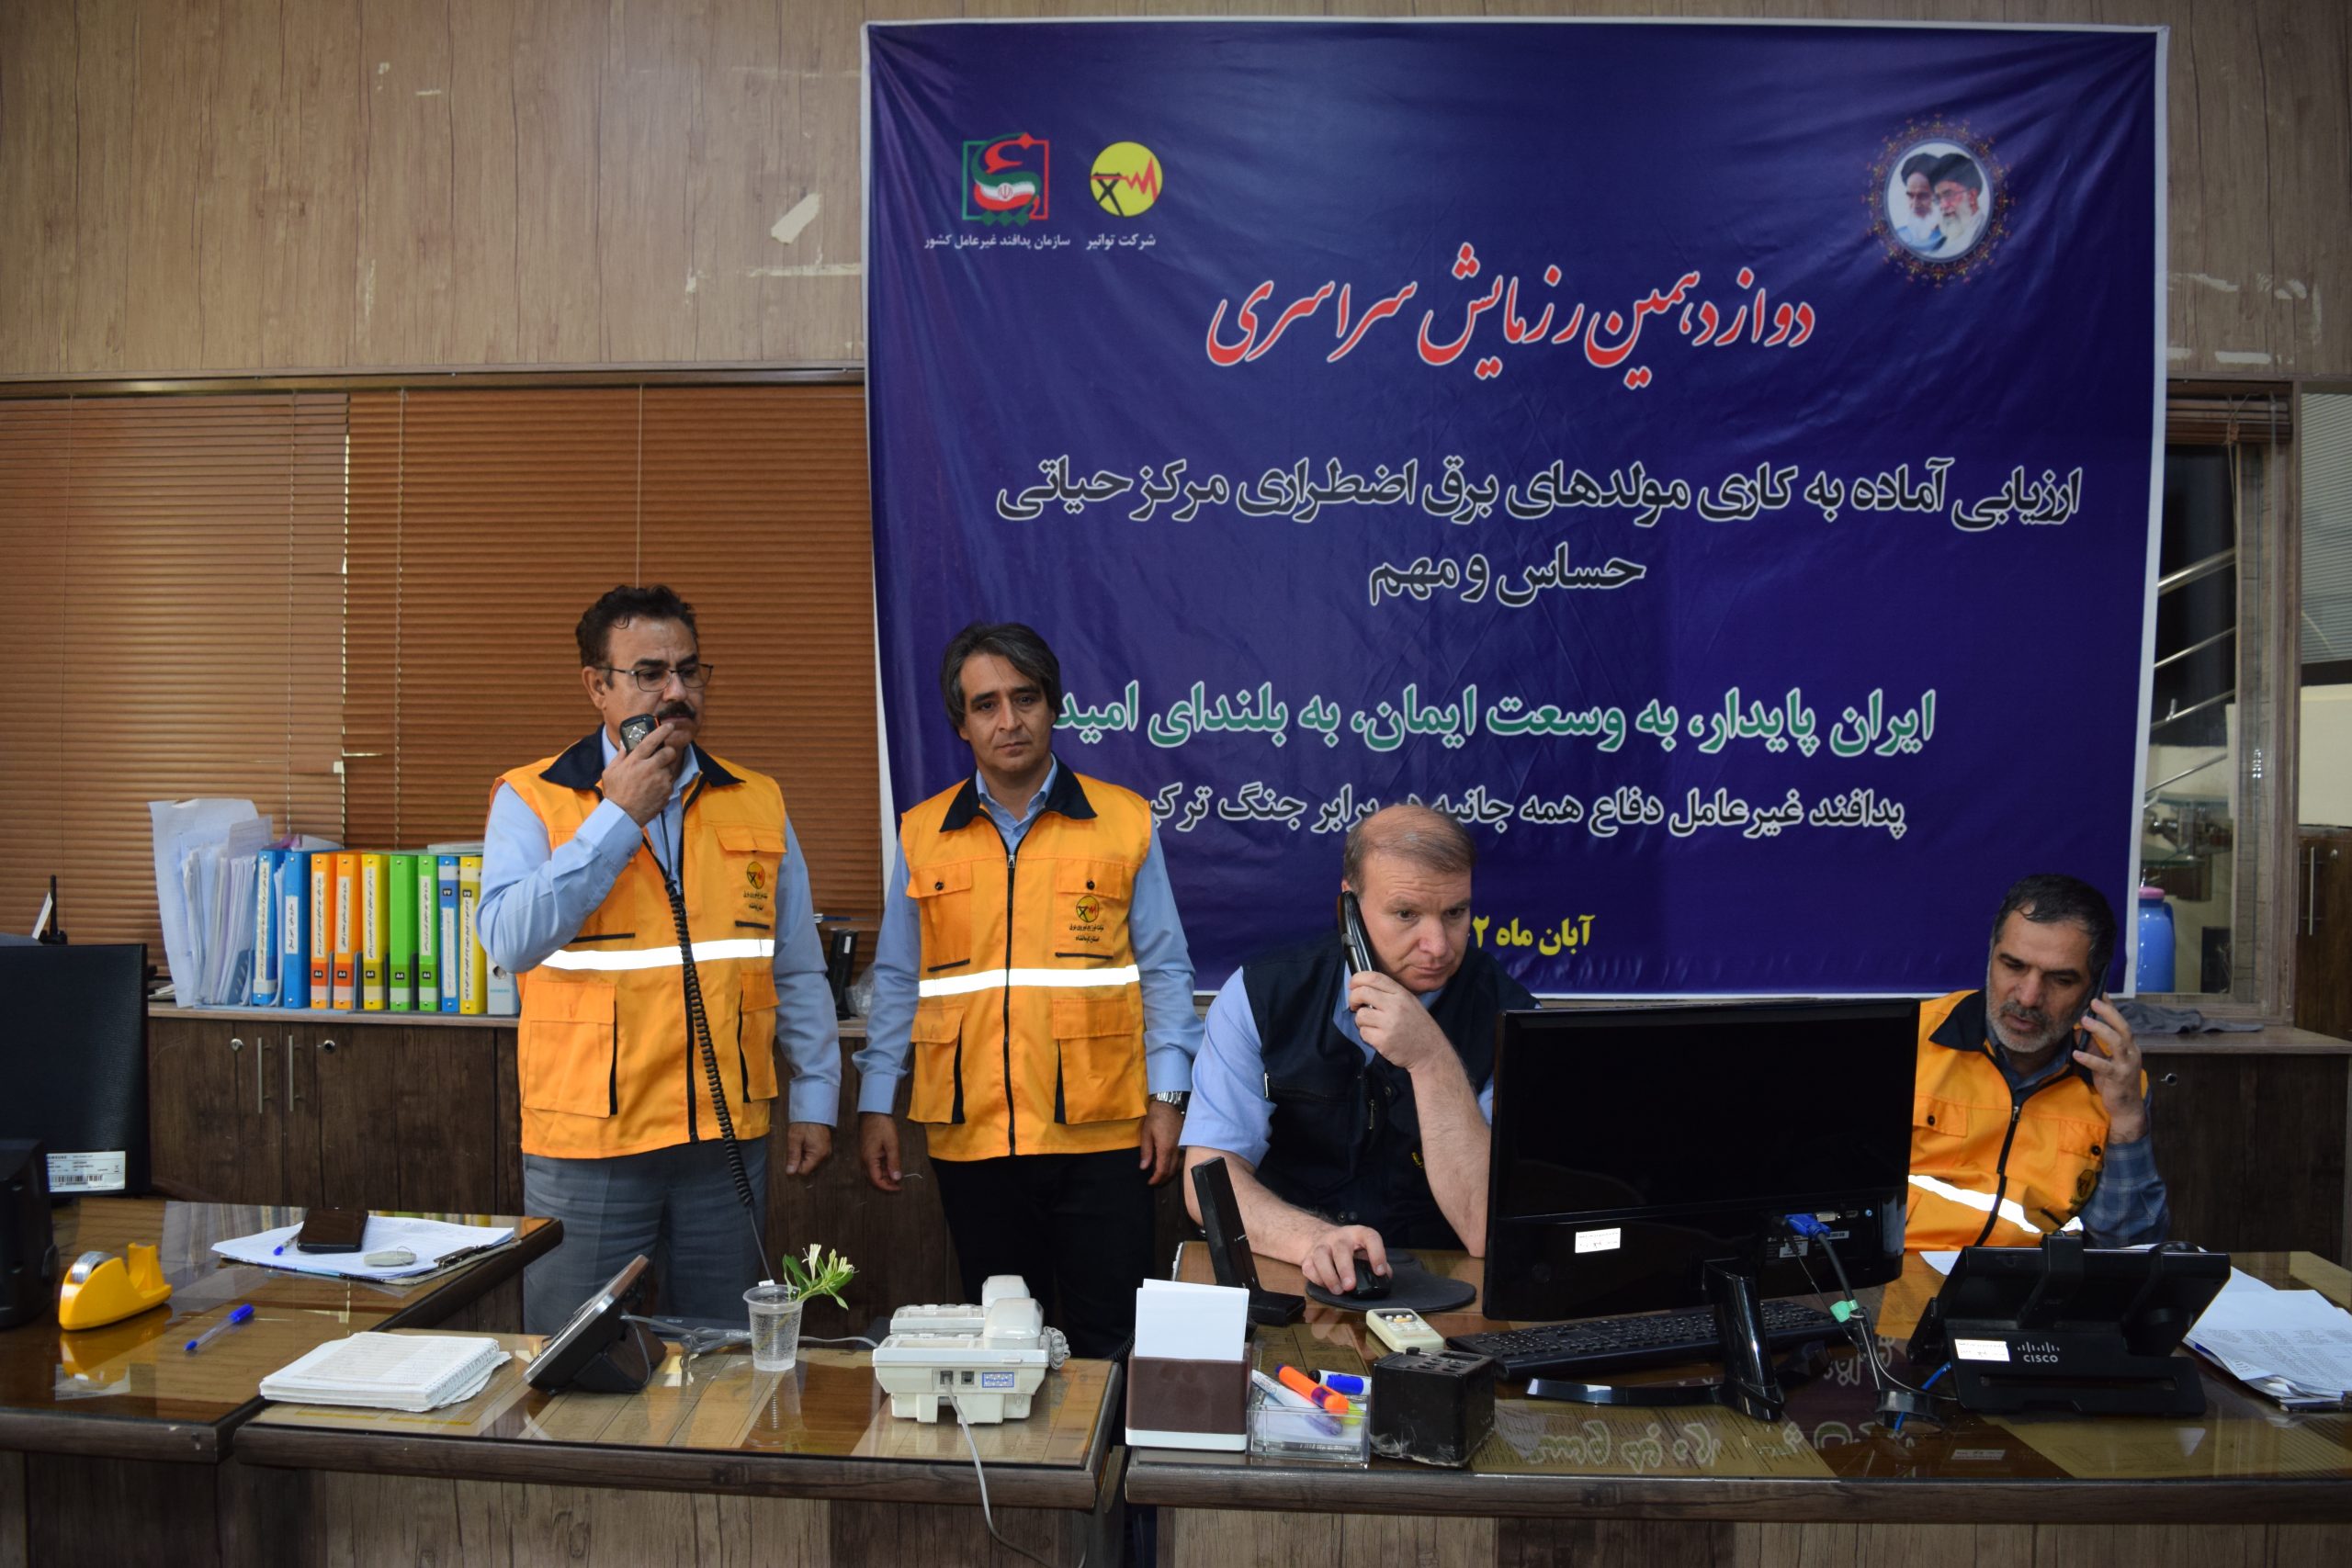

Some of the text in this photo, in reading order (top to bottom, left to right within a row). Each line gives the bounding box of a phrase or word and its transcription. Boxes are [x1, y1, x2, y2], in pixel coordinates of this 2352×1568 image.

[925, 235, 951, 248] کشور
[1001, 235, 1030, 248] پدافند
[1035, 235, 1069, 249] سازمان
[1086, 233, 1156, 251] شرکت توانیر
[1206, 243, 1815, 389] دوازدهمین رزمایش سراسری
[997, 455, 2082, 531] ارزیابی آماده به کاری مولدهای برق اضطراری مرکز حیاتی
[1369, 542, 1646, 607] حساس و مهم
[1053, 680, 1935, 757] ایران پایدار، به وسعت ایمان، به بلندای امید
[1218, 782, 1307, 830] جنگ
[1520, 795, 1583, 824] همه
[1589, 786, 1664, 837] دفاع
[1809, 789, 1906, 839] پدافند
[1497, 919, 1532, 945] ماه
[1540, 916, 1595, 955] آبان
[2023, 1354, 2059, 1363] CISCO
